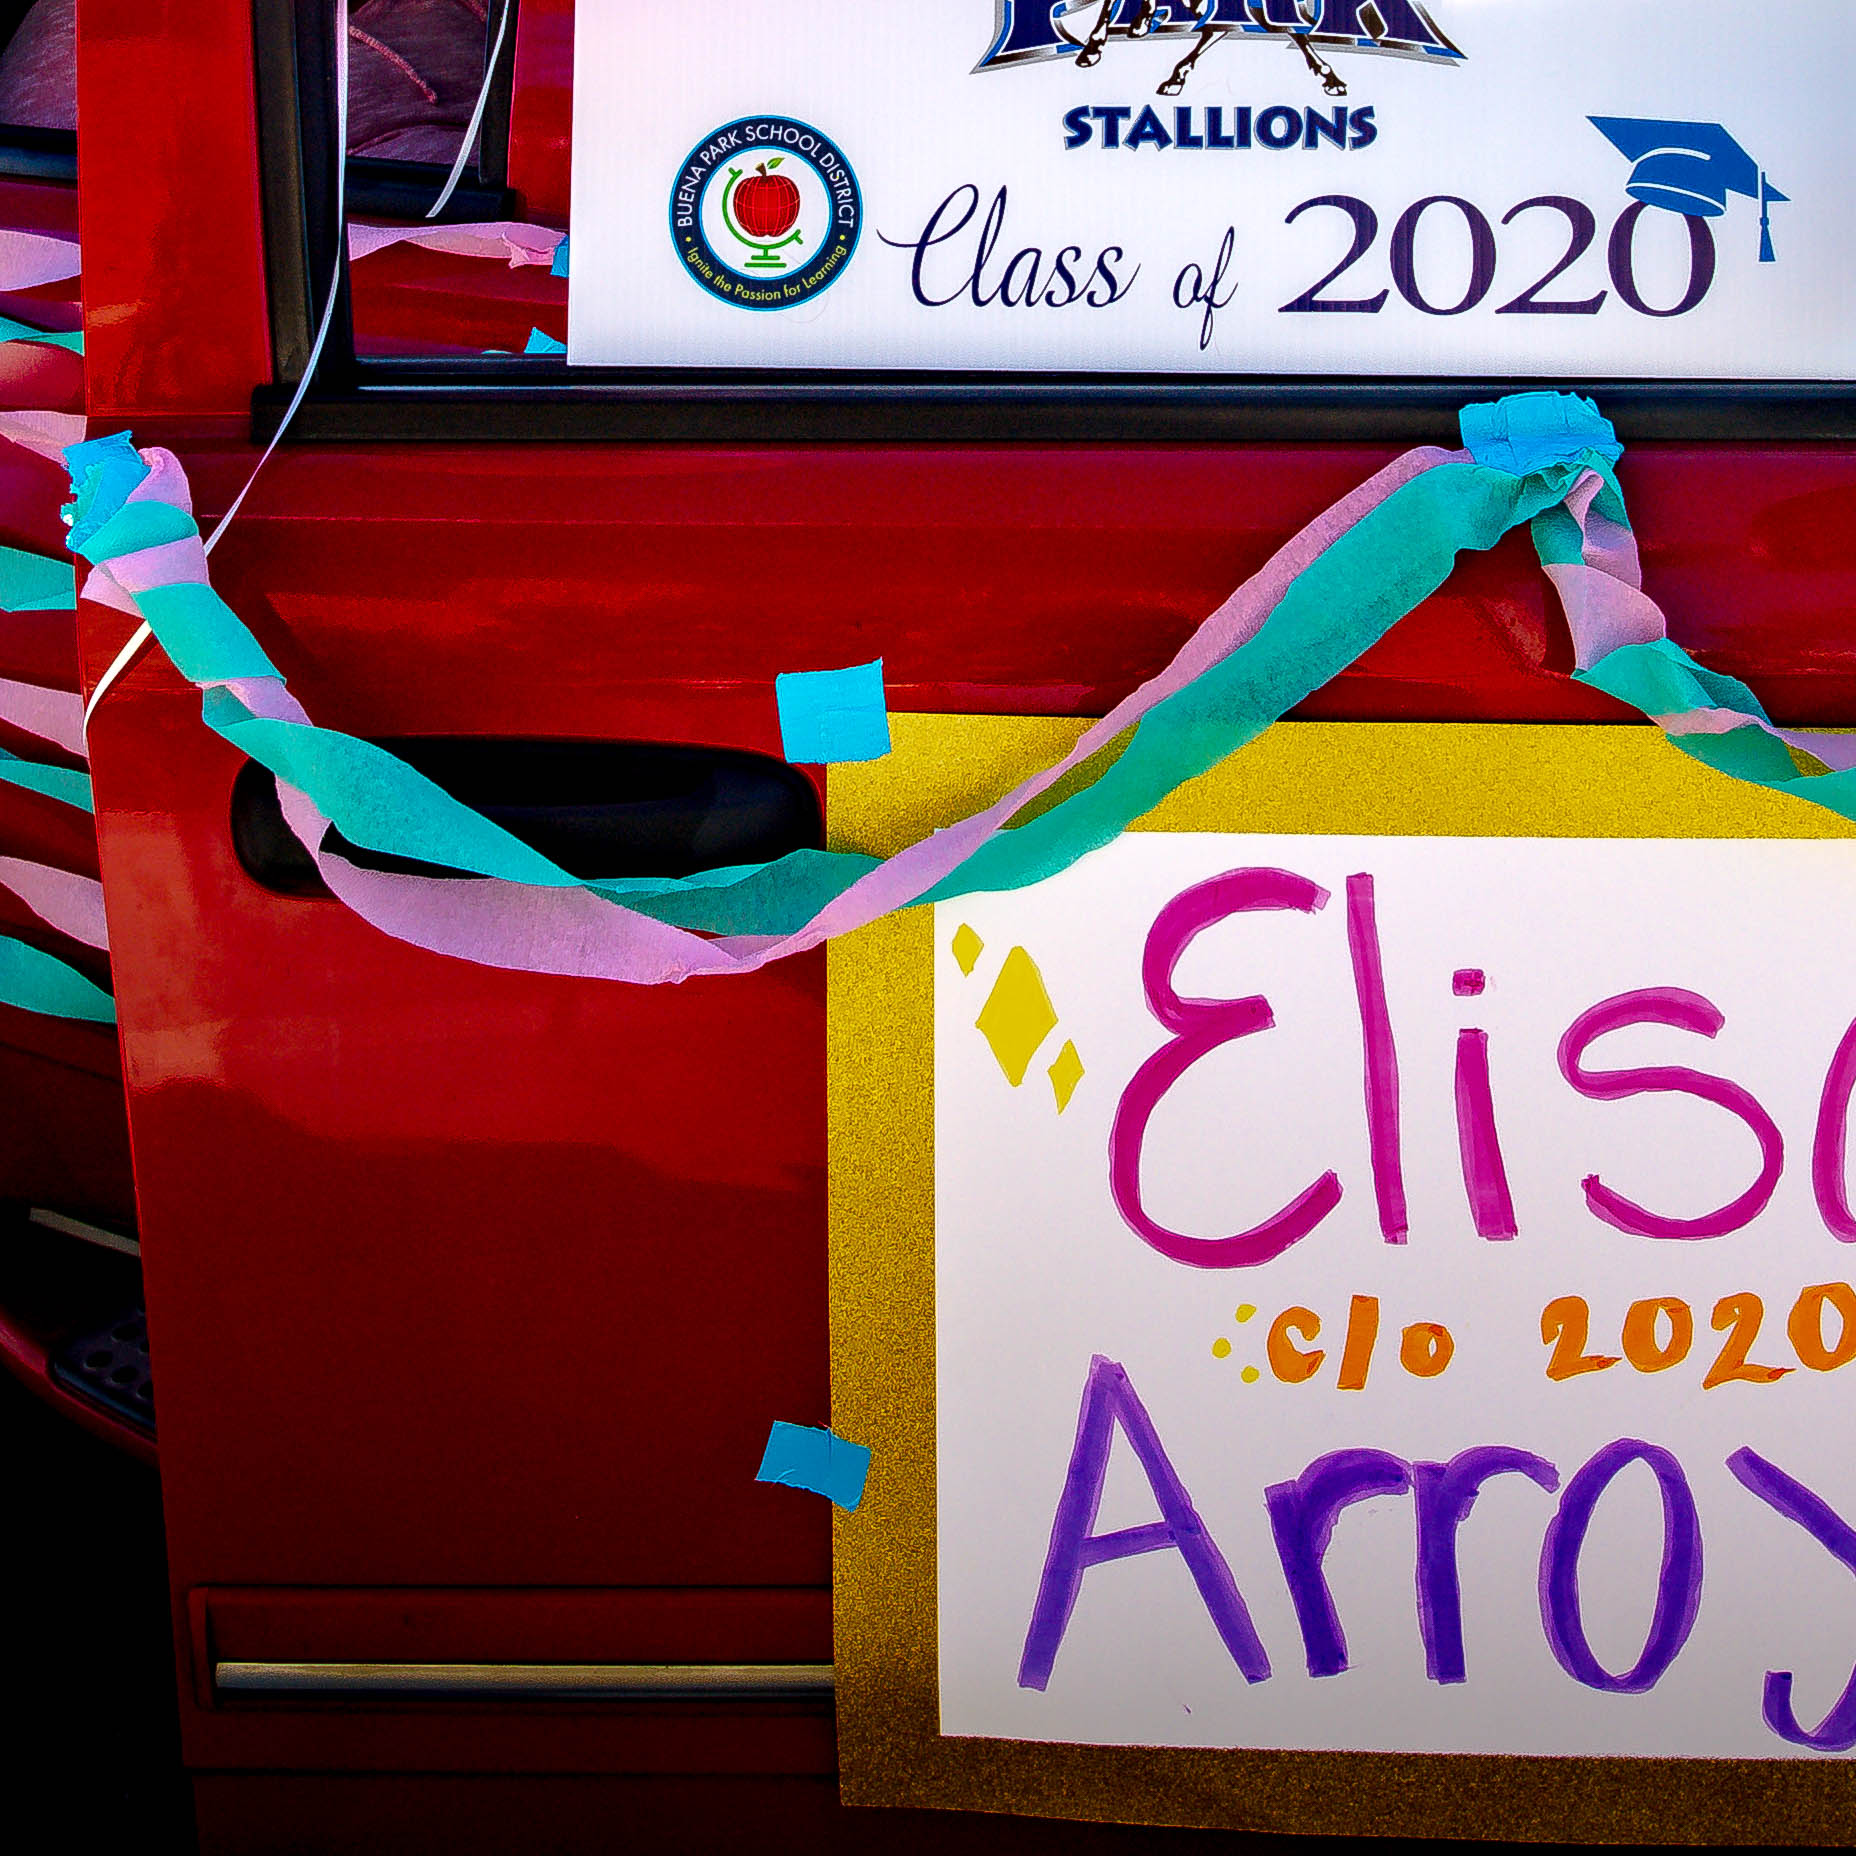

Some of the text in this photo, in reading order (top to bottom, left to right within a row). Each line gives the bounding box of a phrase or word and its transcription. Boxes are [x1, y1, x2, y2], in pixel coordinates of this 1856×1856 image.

[677, 124, 855, 228] BUENA PARK SCHOOL DISTRICT
[1063, 105, 1379, 151] STALLIONS
[687, 245, 847, 301] Ignite the Passion for Learning
[876, 184, 1717, 351] Class of 2020
[1266, 1294, 1455, 1391] c/o
